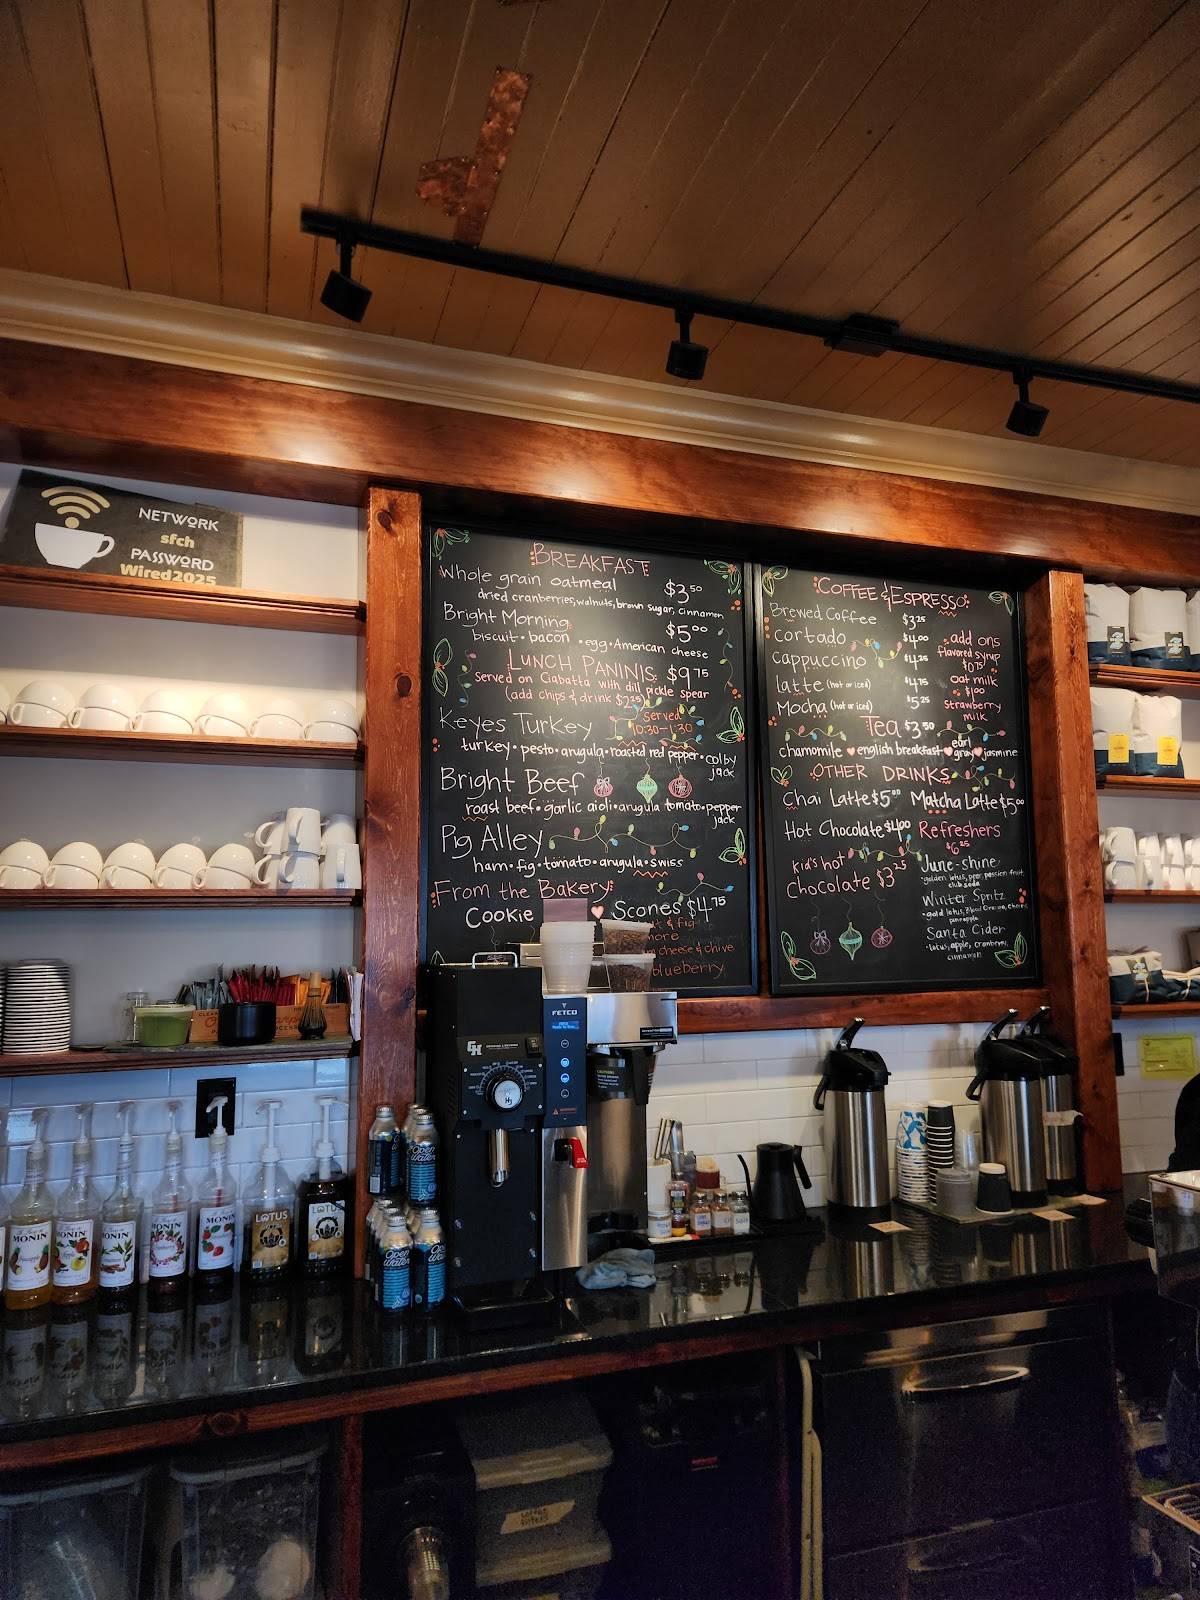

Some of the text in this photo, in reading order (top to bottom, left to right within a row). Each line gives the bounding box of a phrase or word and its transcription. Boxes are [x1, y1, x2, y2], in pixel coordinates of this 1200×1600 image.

[139, 508, 219, 532] NETWORK
[160, 534, 195, 548] sfch
[131, 548, 214, 571] PASSWORD
[533, 542, 650, 576] BREAKFAST
[120, 564, 216, 586] Wired2025
[440, 564, 617, 591] Whole grain oatmeal
[478, 589, 508, 602] dried
[616, 599, 644, 610] brown
[817, 577, 878, 600] COFFEE
[890, 586, 966, 609] ESPRESSO
[443, 602, 569, 633] Bright Morning
[769, 603, 877, 624] Brewed Coffee
[950, 631, 972, 646] add
[978, 636, 1000, 647] ons
[508, 649, 571, 671] LUNCH
[671, 647, 708, 659] cheese
[937, 646, 973, 659] flavored
[975, 651, 1000, 666] syrup
[519, 675, 533, 683] on
[625, 679, 640, 693] dill
[646, 684, 674, 698] pickle
[680, 688, 709, 700] spear
[973, 676, 998, 686] milk
[506, 687, 533, 702] (add
[539, 688, 566, 704] chips
[579, 691, 612, 703] drink
[777, 699, 827, 716] Mocha
[963, 712, 987, 721] milk
[439, 707, 592, 741] Keyes Turkey
[860, 716, 902, 737] Tea
[461, 737, 510, 762] turkey
[521, 742, 553, 763] pesto
[649, 746, 664, 758] red
[857, 743, 893, 757] english
[896, 743, 943, 756] breakfast
[952, 738, 971, 748] earl
[441, 767, 585, 800] Bright Beef
[708, 767, 735, 781] jack
[813, 763, 950, 785] OTHER DRINKS
[466, 800, 499, 816] roast
[506, 799, 535, 814] beef
[544, 799, 581, 820] garlic
[664, 798, 700, 810] tomato
[706, 802, 741, 817] pepper
[783, 791, 821, 806] Chai
[830, 788, 868, 807] Latte
[911, 790, 962, 810] Matcha
[965, 793, 997, 810] Latte
[713, 814, 735, 829] jack
[785, 821, 812, 840] Hot
[819, 819, 885, 837] Chocolate
[919, 821, 1000, 839] Refreshers
[442, 823, 543, 859] Pig Alley
[473, 857, 508, 873] ham
[516, 858, 535, 878] fig
[543, 856, 591, 870] tomato
[821, 851, 845, 870] hot
[434, 881, 490, 906] From
[499, 881, 526, 898] the
[922, 891, 967, 907] Winter
[466, 900, 681, 928] Cookie Scones
[677, 917, 695, 928] fig
[926, 921, 1005, 940] Santa Cider
[255, 1211, 288, 1223] LOTUS
[13, 1233, 47, 1241] MONIN
